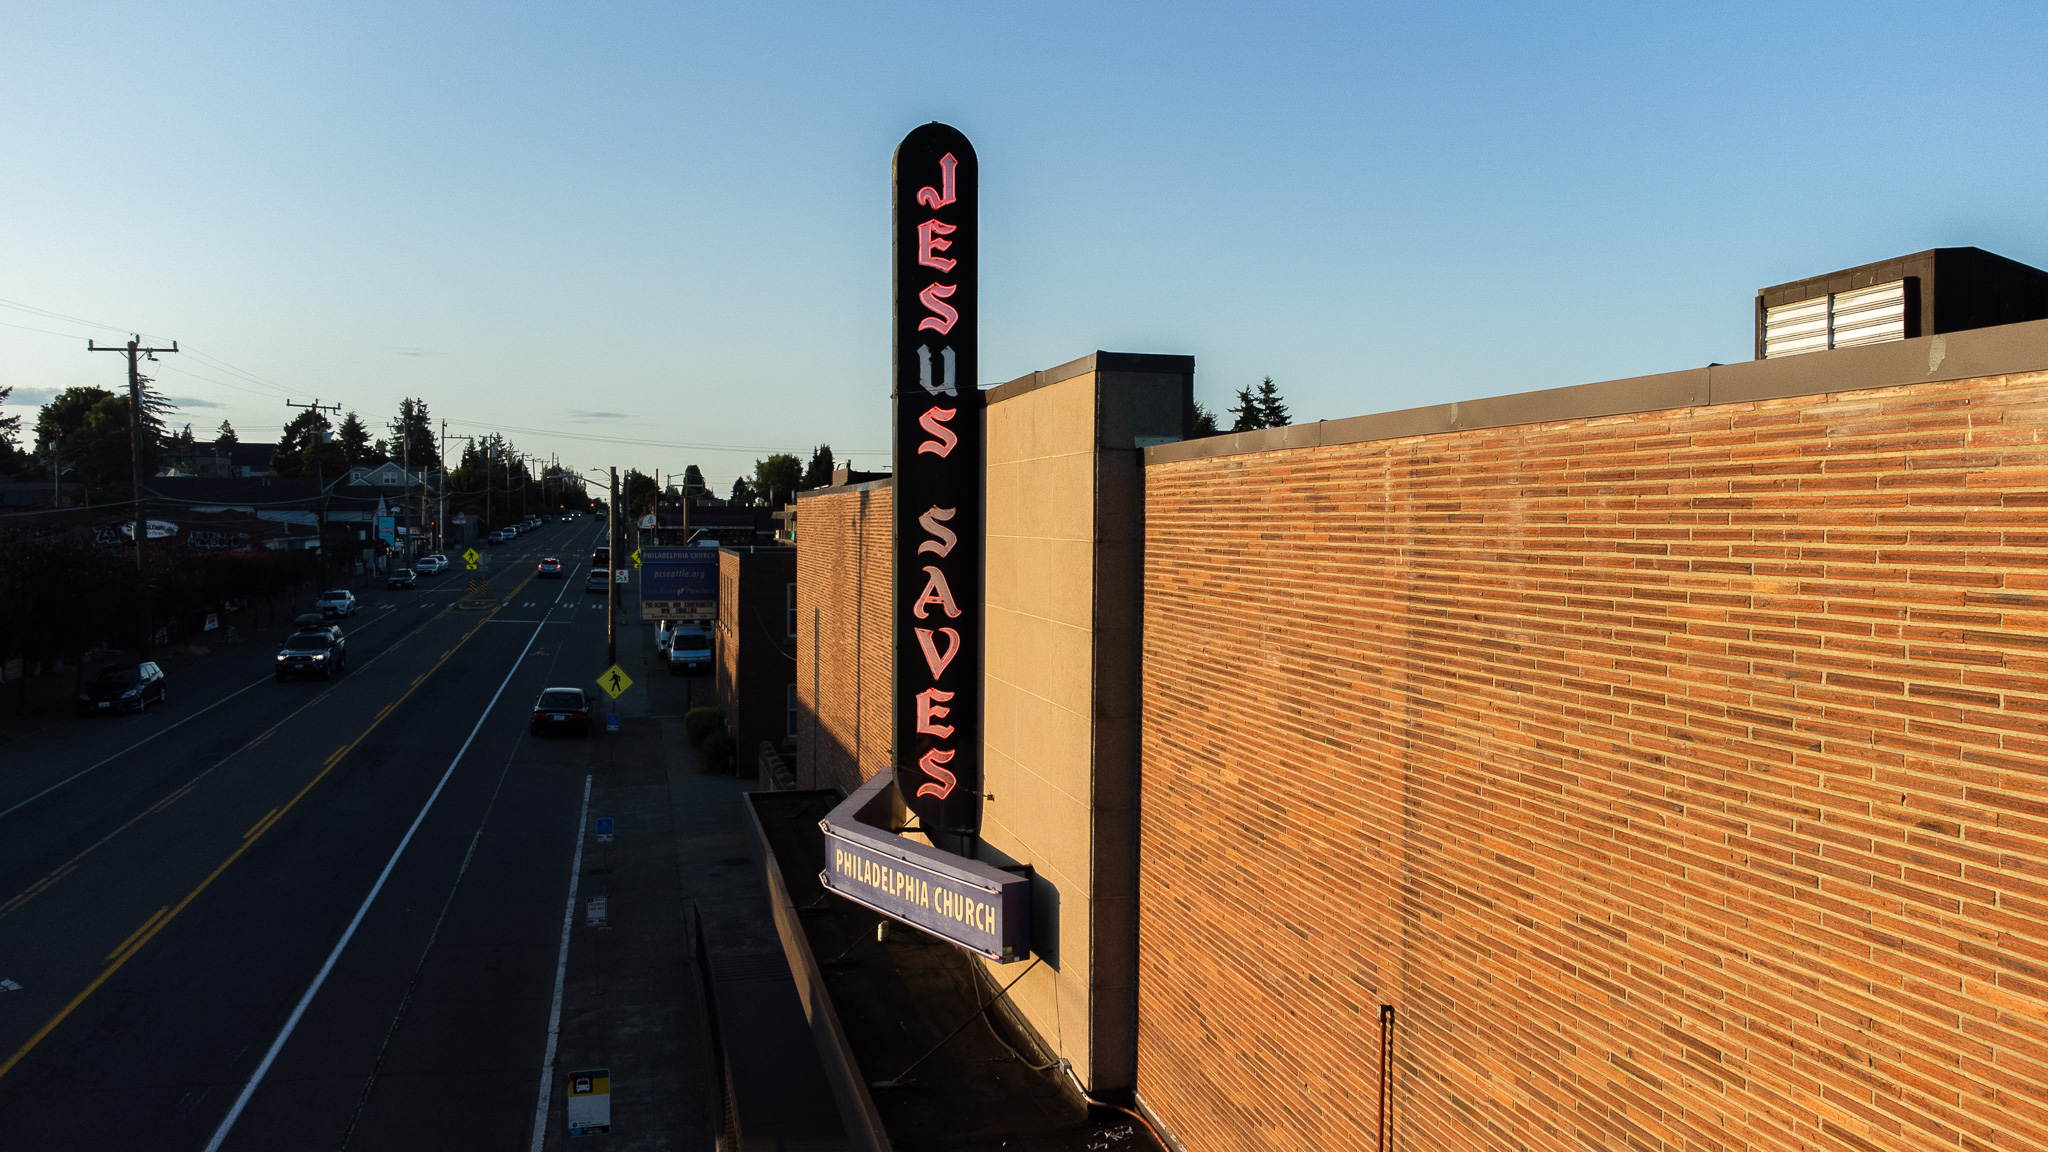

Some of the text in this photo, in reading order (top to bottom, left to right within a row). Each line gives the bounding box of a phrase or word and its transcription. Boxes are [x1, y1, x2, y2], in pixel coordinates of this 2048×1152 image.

[913, 152, 962, 800] JESUS SAVES
[654, 570, 705, 579] pcseattle.org
[835, 848, 996, 936] PHILADELPHIA CHURCH
